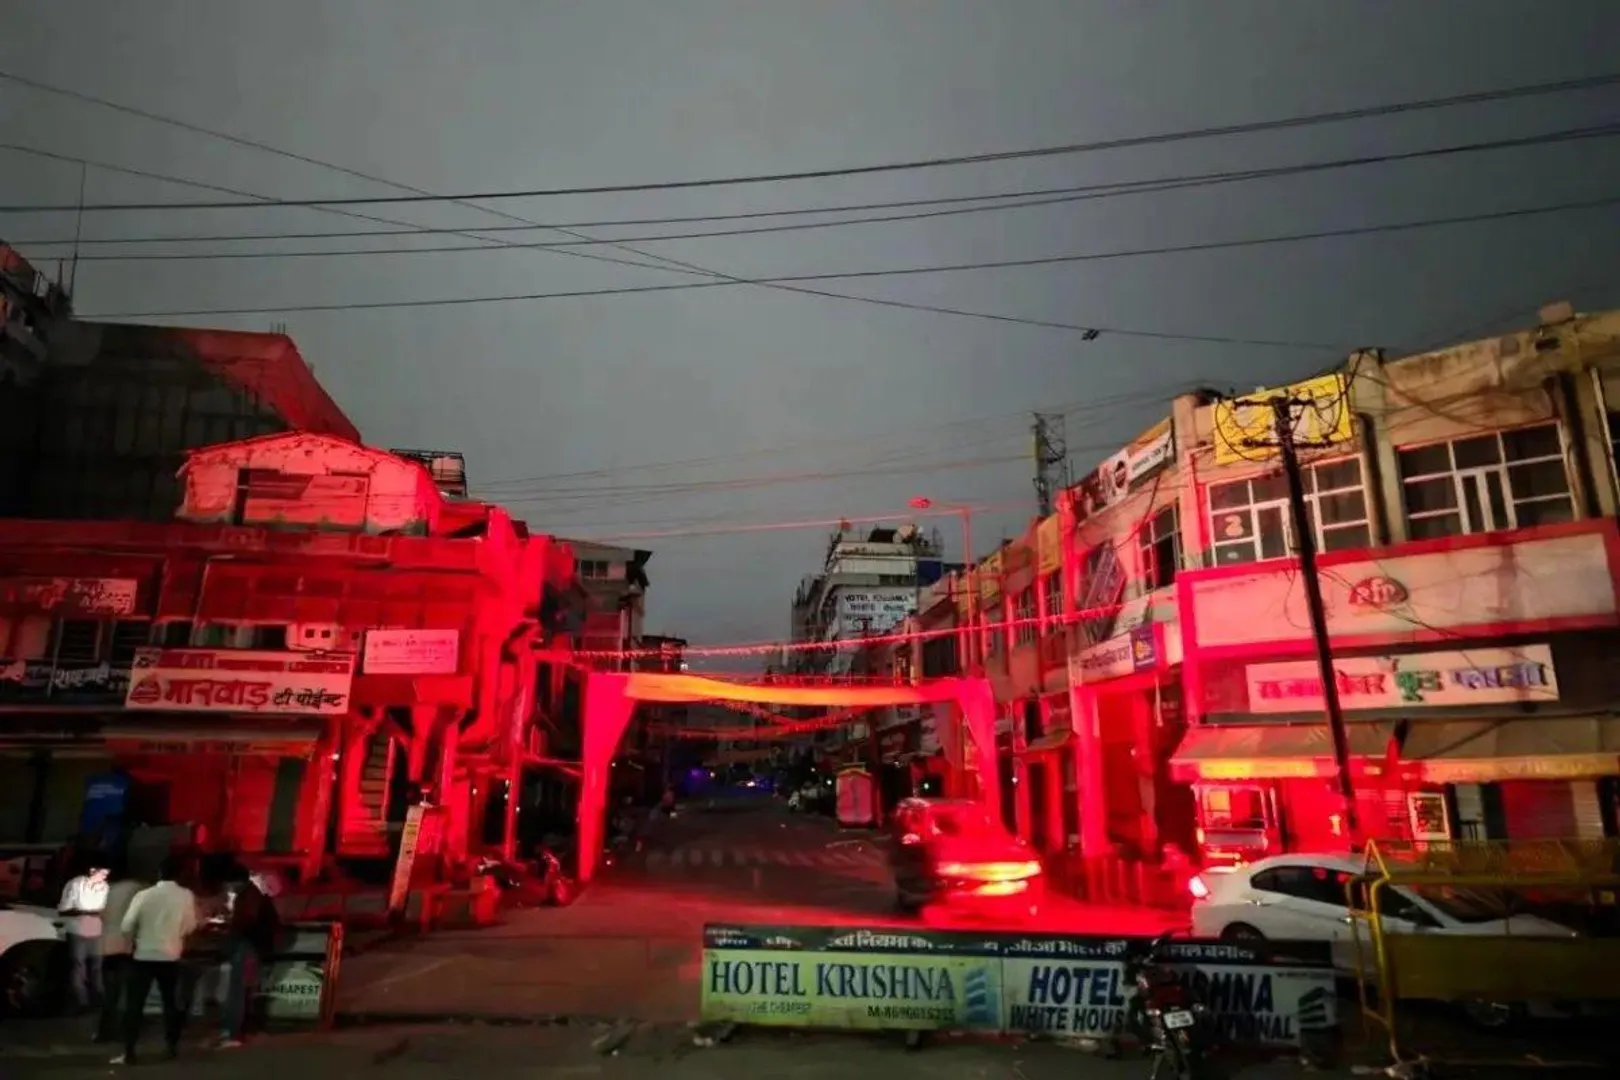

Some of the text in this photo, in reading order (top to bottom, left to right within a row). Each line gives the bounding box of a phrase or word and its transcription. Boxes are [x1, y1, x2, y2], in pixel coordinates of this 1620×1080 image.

[711, 961, 955, 1000] HOTEL KRISHNA
[1028, 966, 1124, 1005] HOTEL
[1008, 1004, 1067, 1031] WHITE
[1071, 1007, 1124, 1034] HOUS
